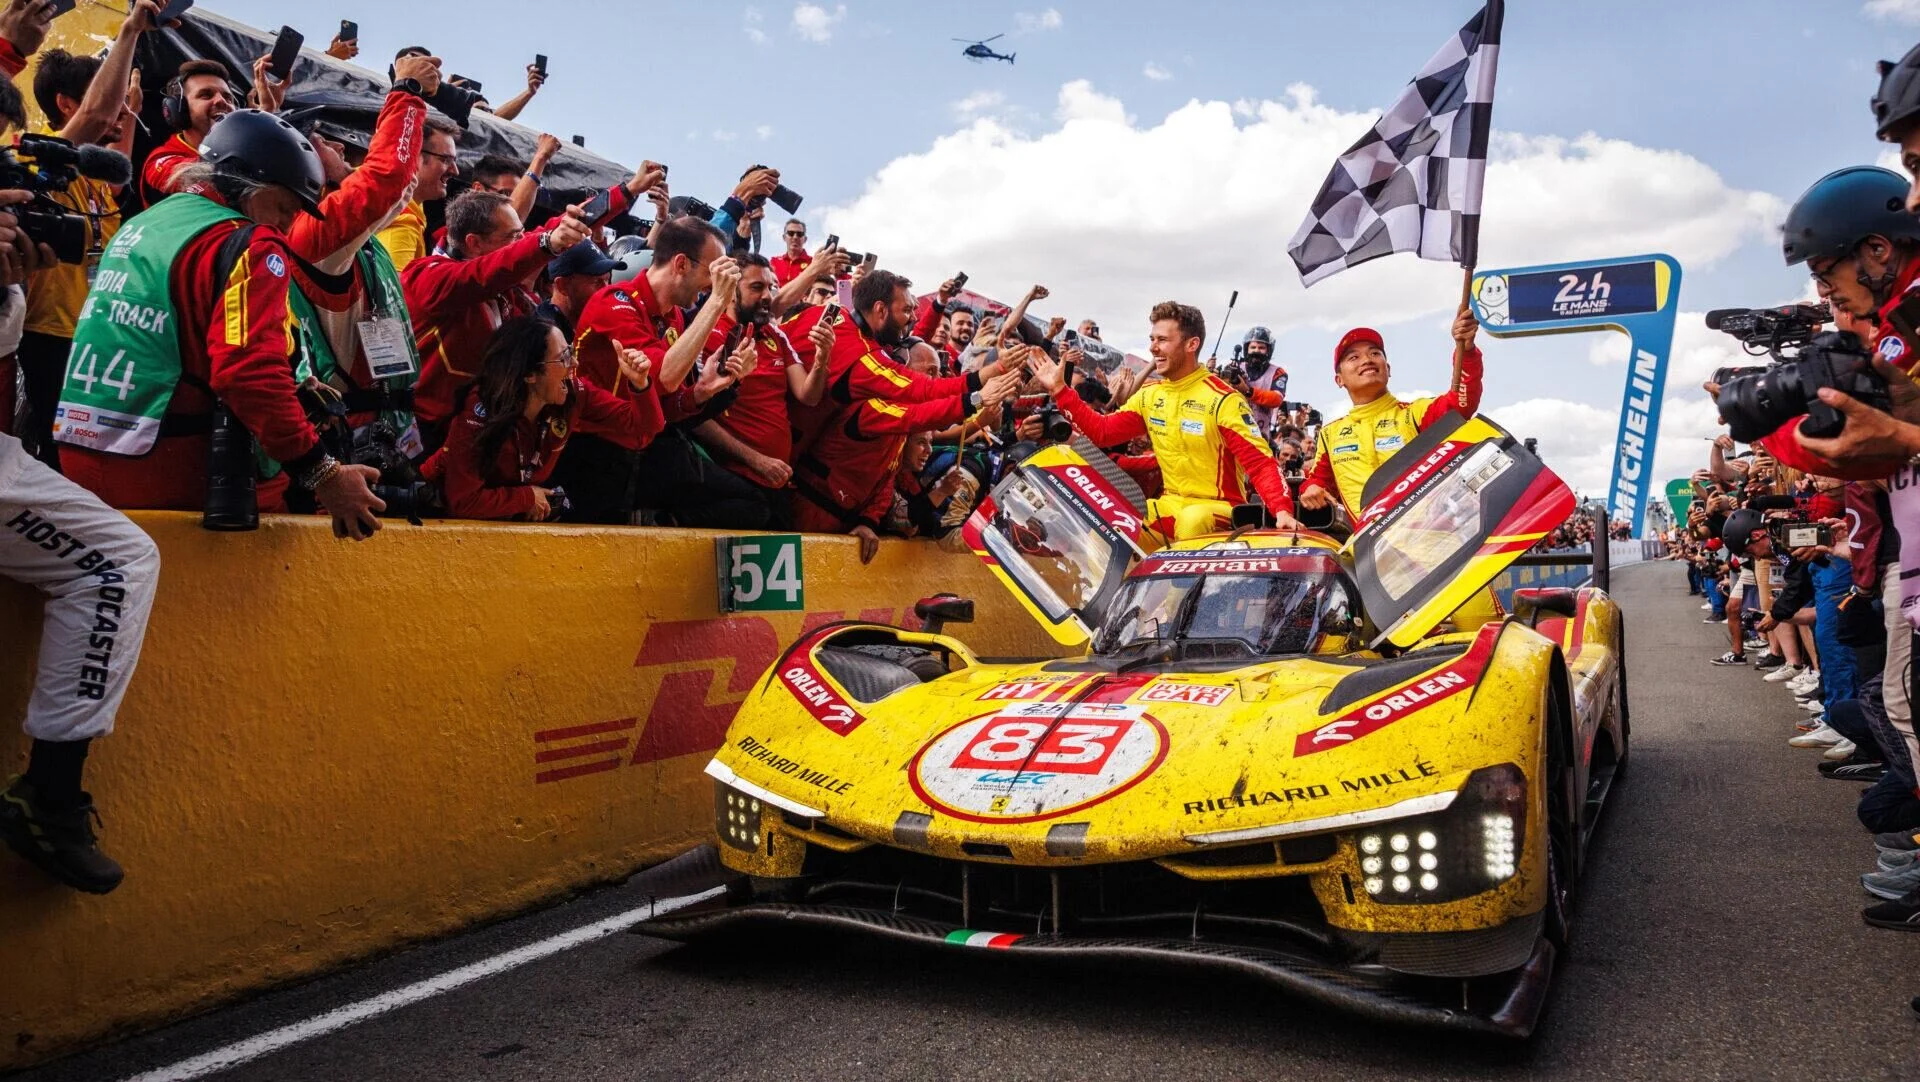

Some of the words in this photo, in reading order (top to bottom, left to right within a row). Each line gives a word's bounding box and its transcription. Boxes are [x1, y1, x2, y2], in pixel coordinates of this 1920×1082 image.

[95, 269, 129, 293] EDIA
[269, 254, 284, 277] hp
[1554, 271, 1611, 303] 24h
[108, 300, 169, 333] TRACK
[1552, 302, 1568, 312] LE
[1570, 299, 1608, 310] MANS
[74, 427, 98, 439] BOSCH
[1612, 349, 1658, 523] MICHELIN
[1394, 441, 1456, 494] ORLEN
[1065, 466, 1115, 511] ORLEN
[6, 510, 87, 559] HOST
[1151, 558, 1281, 574] Ferrari
[1223, 548, 1281, 559] POZZI
[731, 543, 802, 603] 54
[785, 667, 834, 707] ORLEN
[1147, 690, 1220, 704] CAR
[1157, 684, 1227, 694] HYPER
[1365, 671, 1467, 720] ORLEN
[970, 722, 1120, 764] 83
[737, 735, 799, 775] RICHARD
[795, 768, 855, 796] MILLE
[977, 772, 1057, 785] WEC
[1183, 784, 1330, 815] RICHARD
[1341, 760, 1440, 793] MILLE
